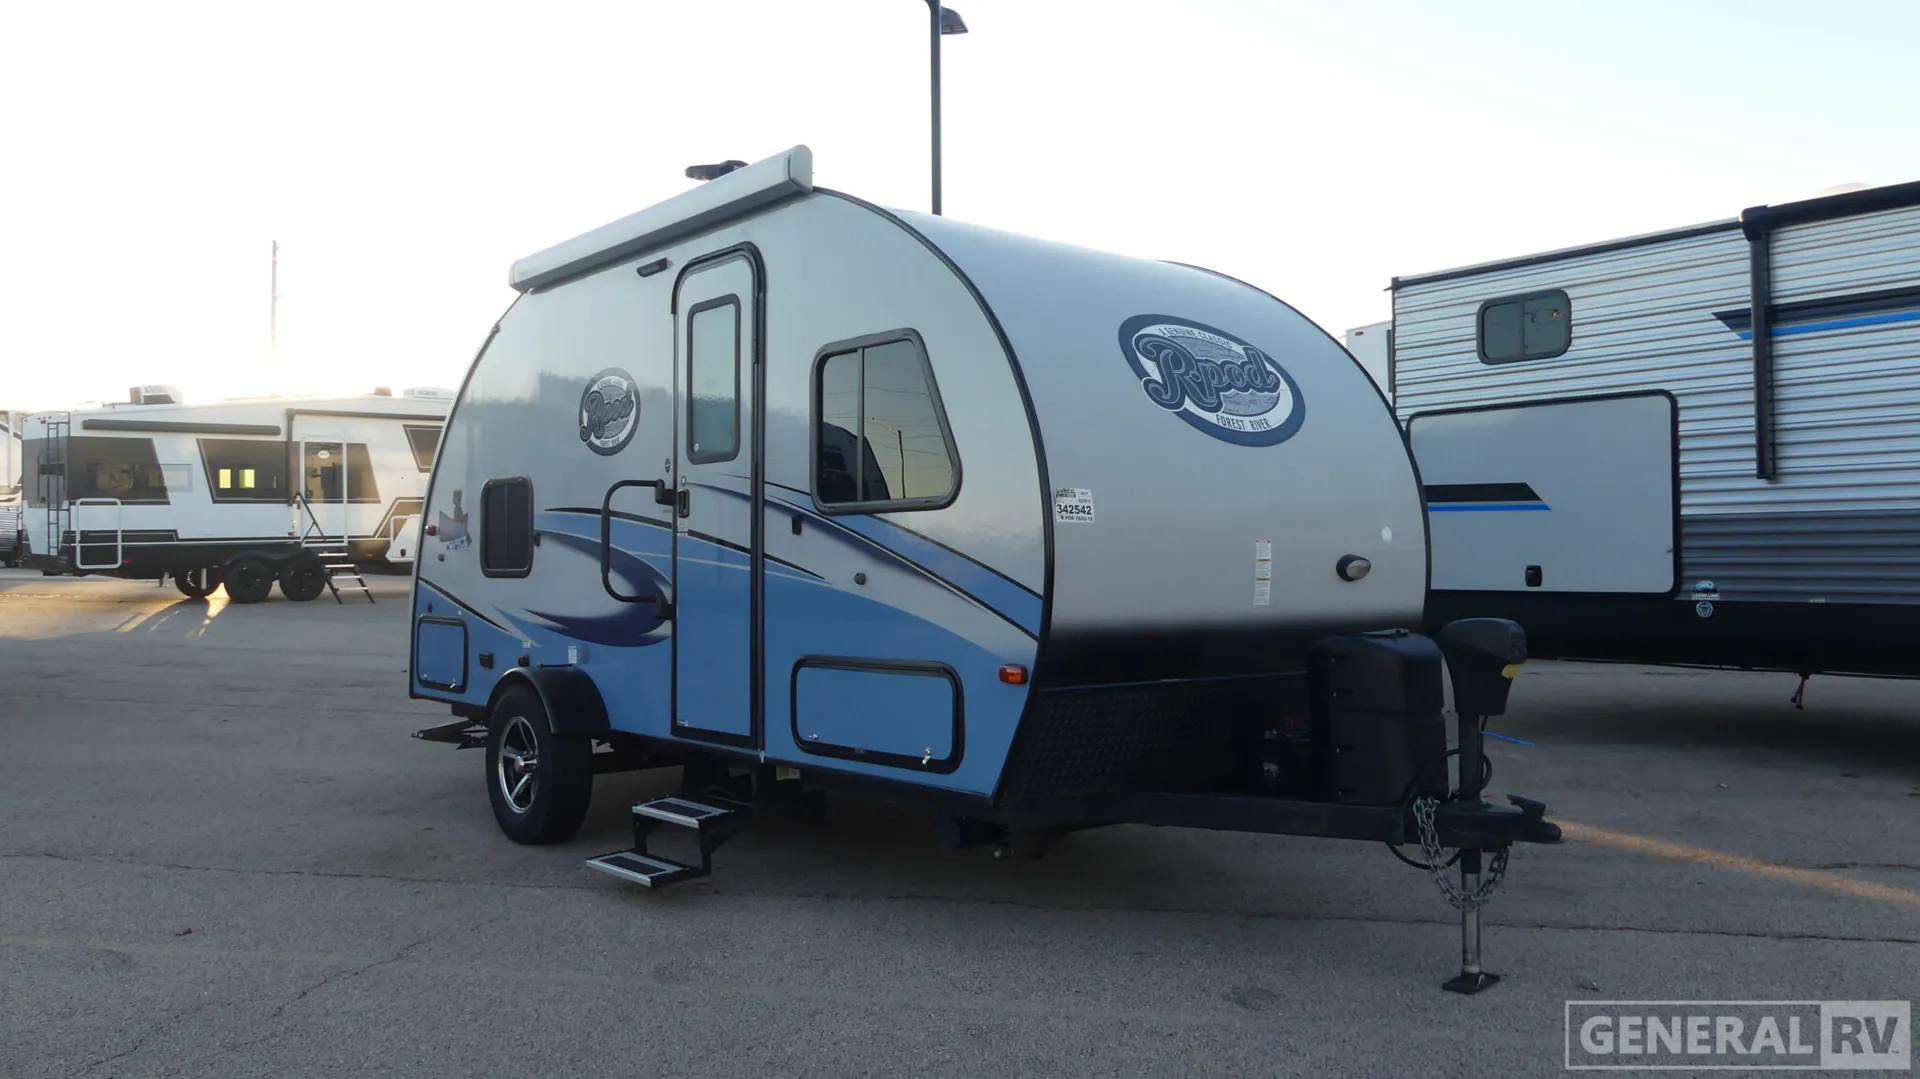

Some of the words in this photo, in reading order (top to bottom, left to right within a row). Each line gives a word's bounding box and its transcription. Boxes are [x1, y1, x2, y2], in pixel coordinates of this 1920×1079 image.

[1200, 331, 1232, 348] CLASSIC
[1215, 414, 1245, 430] FOREST
[1249, 417, 1272, 431] RIVER
[1056, 503, 1092, 515] 342542
